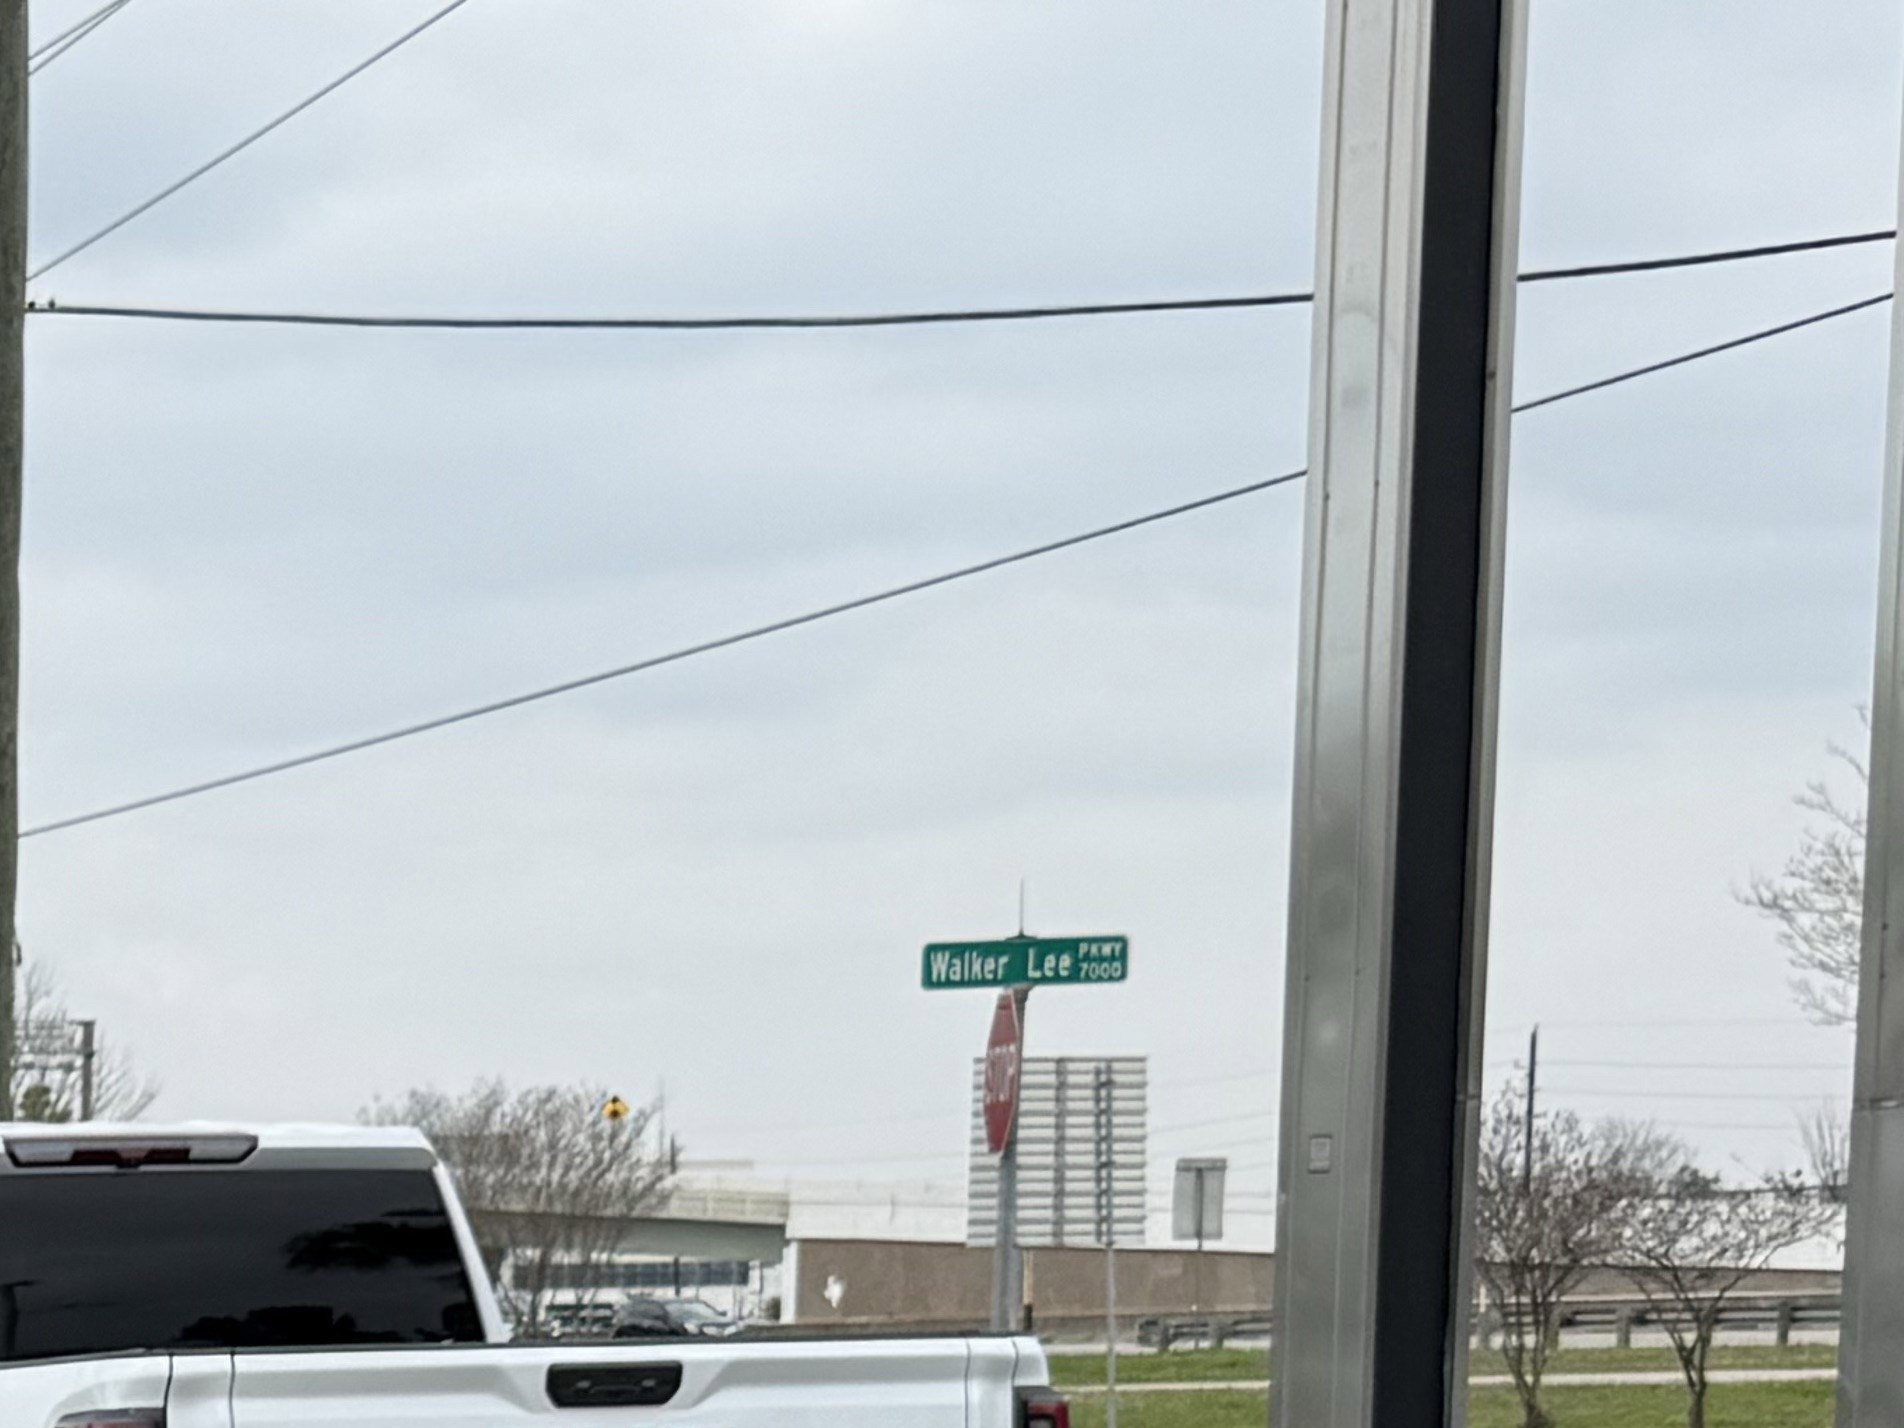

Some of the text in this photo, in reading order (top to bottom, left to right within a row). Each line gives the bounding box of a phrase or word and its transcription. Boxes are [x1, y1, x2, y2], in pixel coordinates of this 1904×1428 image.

[1077, 942, 1123, 959] PKWY
[930, 947, 1073, 983] Walker Lee
[1078, 961, 1123, 979] 7000
